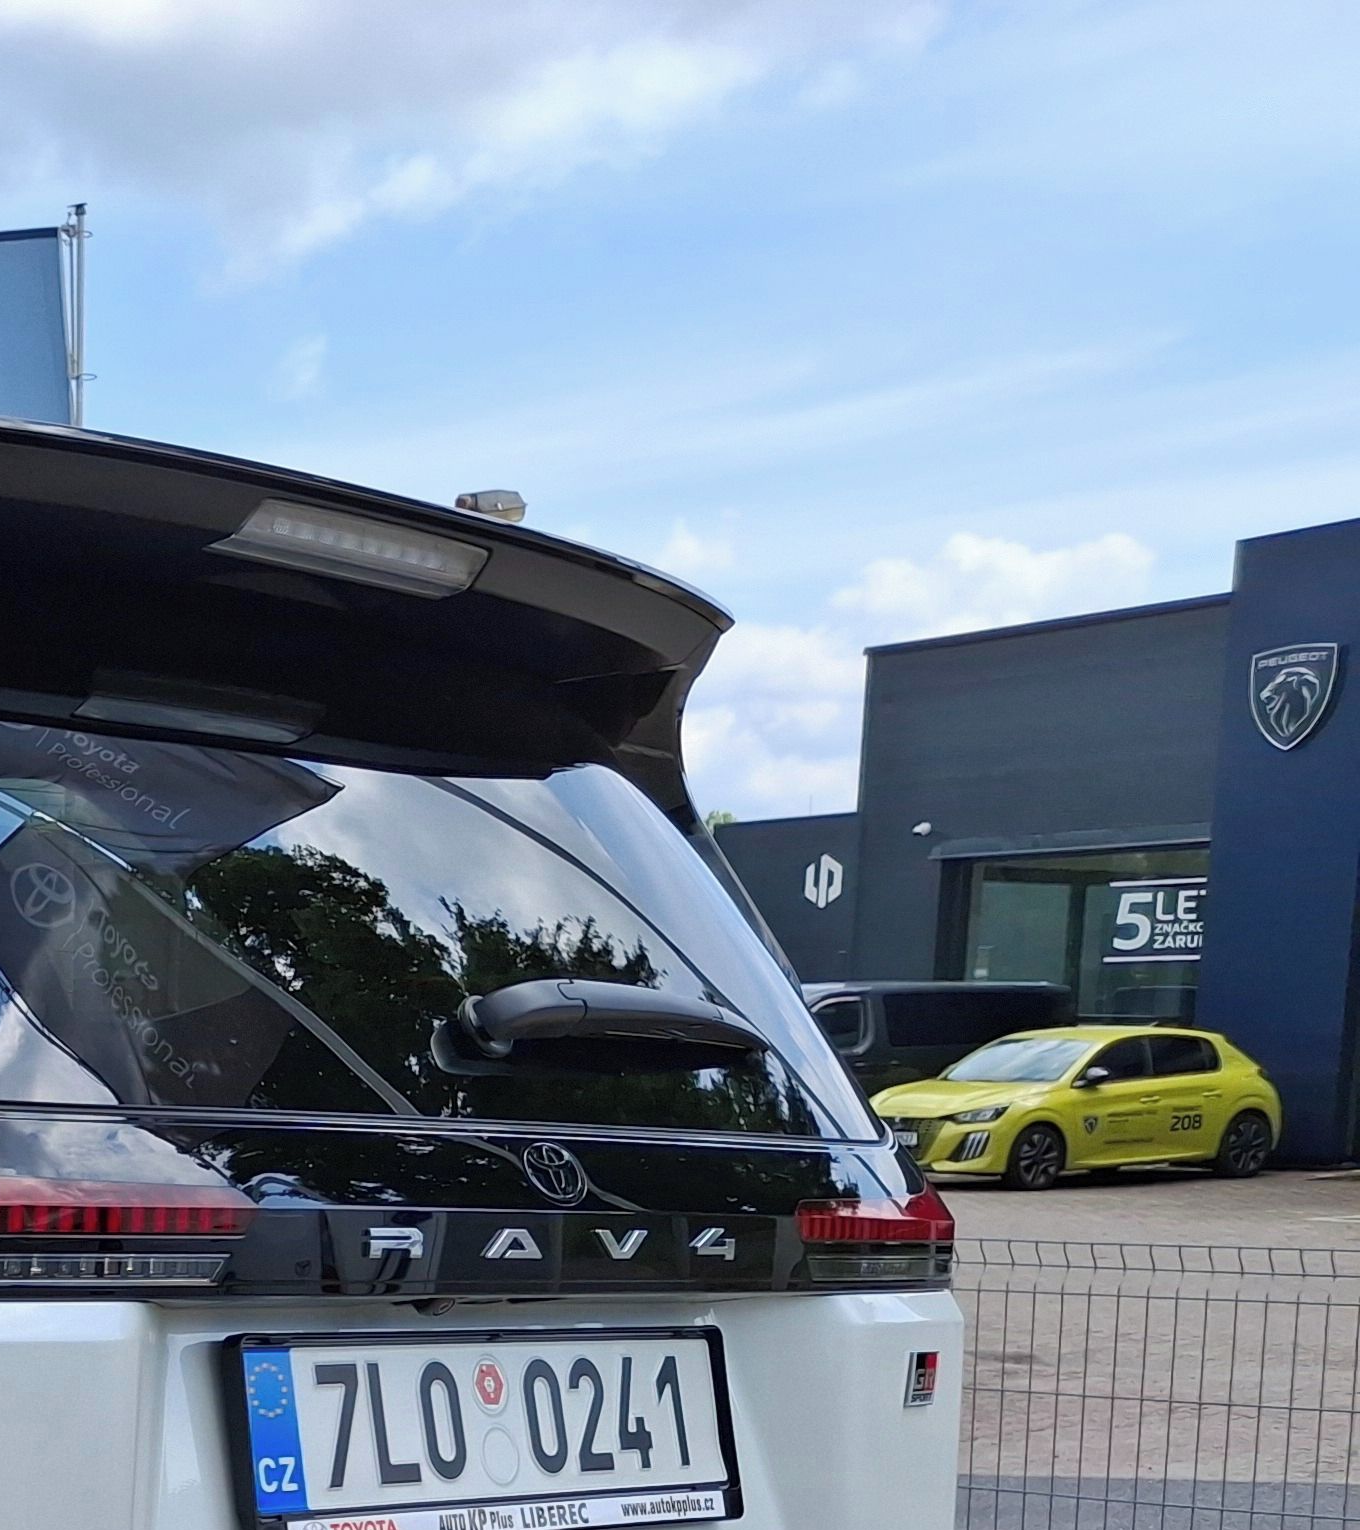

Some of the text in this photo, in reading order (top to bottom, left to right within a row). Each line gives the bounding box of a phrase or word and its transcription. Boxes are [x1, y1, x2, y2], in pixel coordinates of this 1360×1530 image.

[1257, 652, 1328, 670] PEUGEOT
[47, 742, 192, 830] Professional
[1113, 890, 1207, 951] 5 LE
[1169, 1113, 1202, 1132] 208
[362, 1227, 735, 1260] RAV4
[523, 1355, 691, 1474] 0241
[258, 1456, 298, 1492] CZ
[490, 1511, 514, 1530] Plus
[520, 1502, 590, 1529] LIBEREC
[621, 1495, 715, 1517] www.autokpplus.cz
